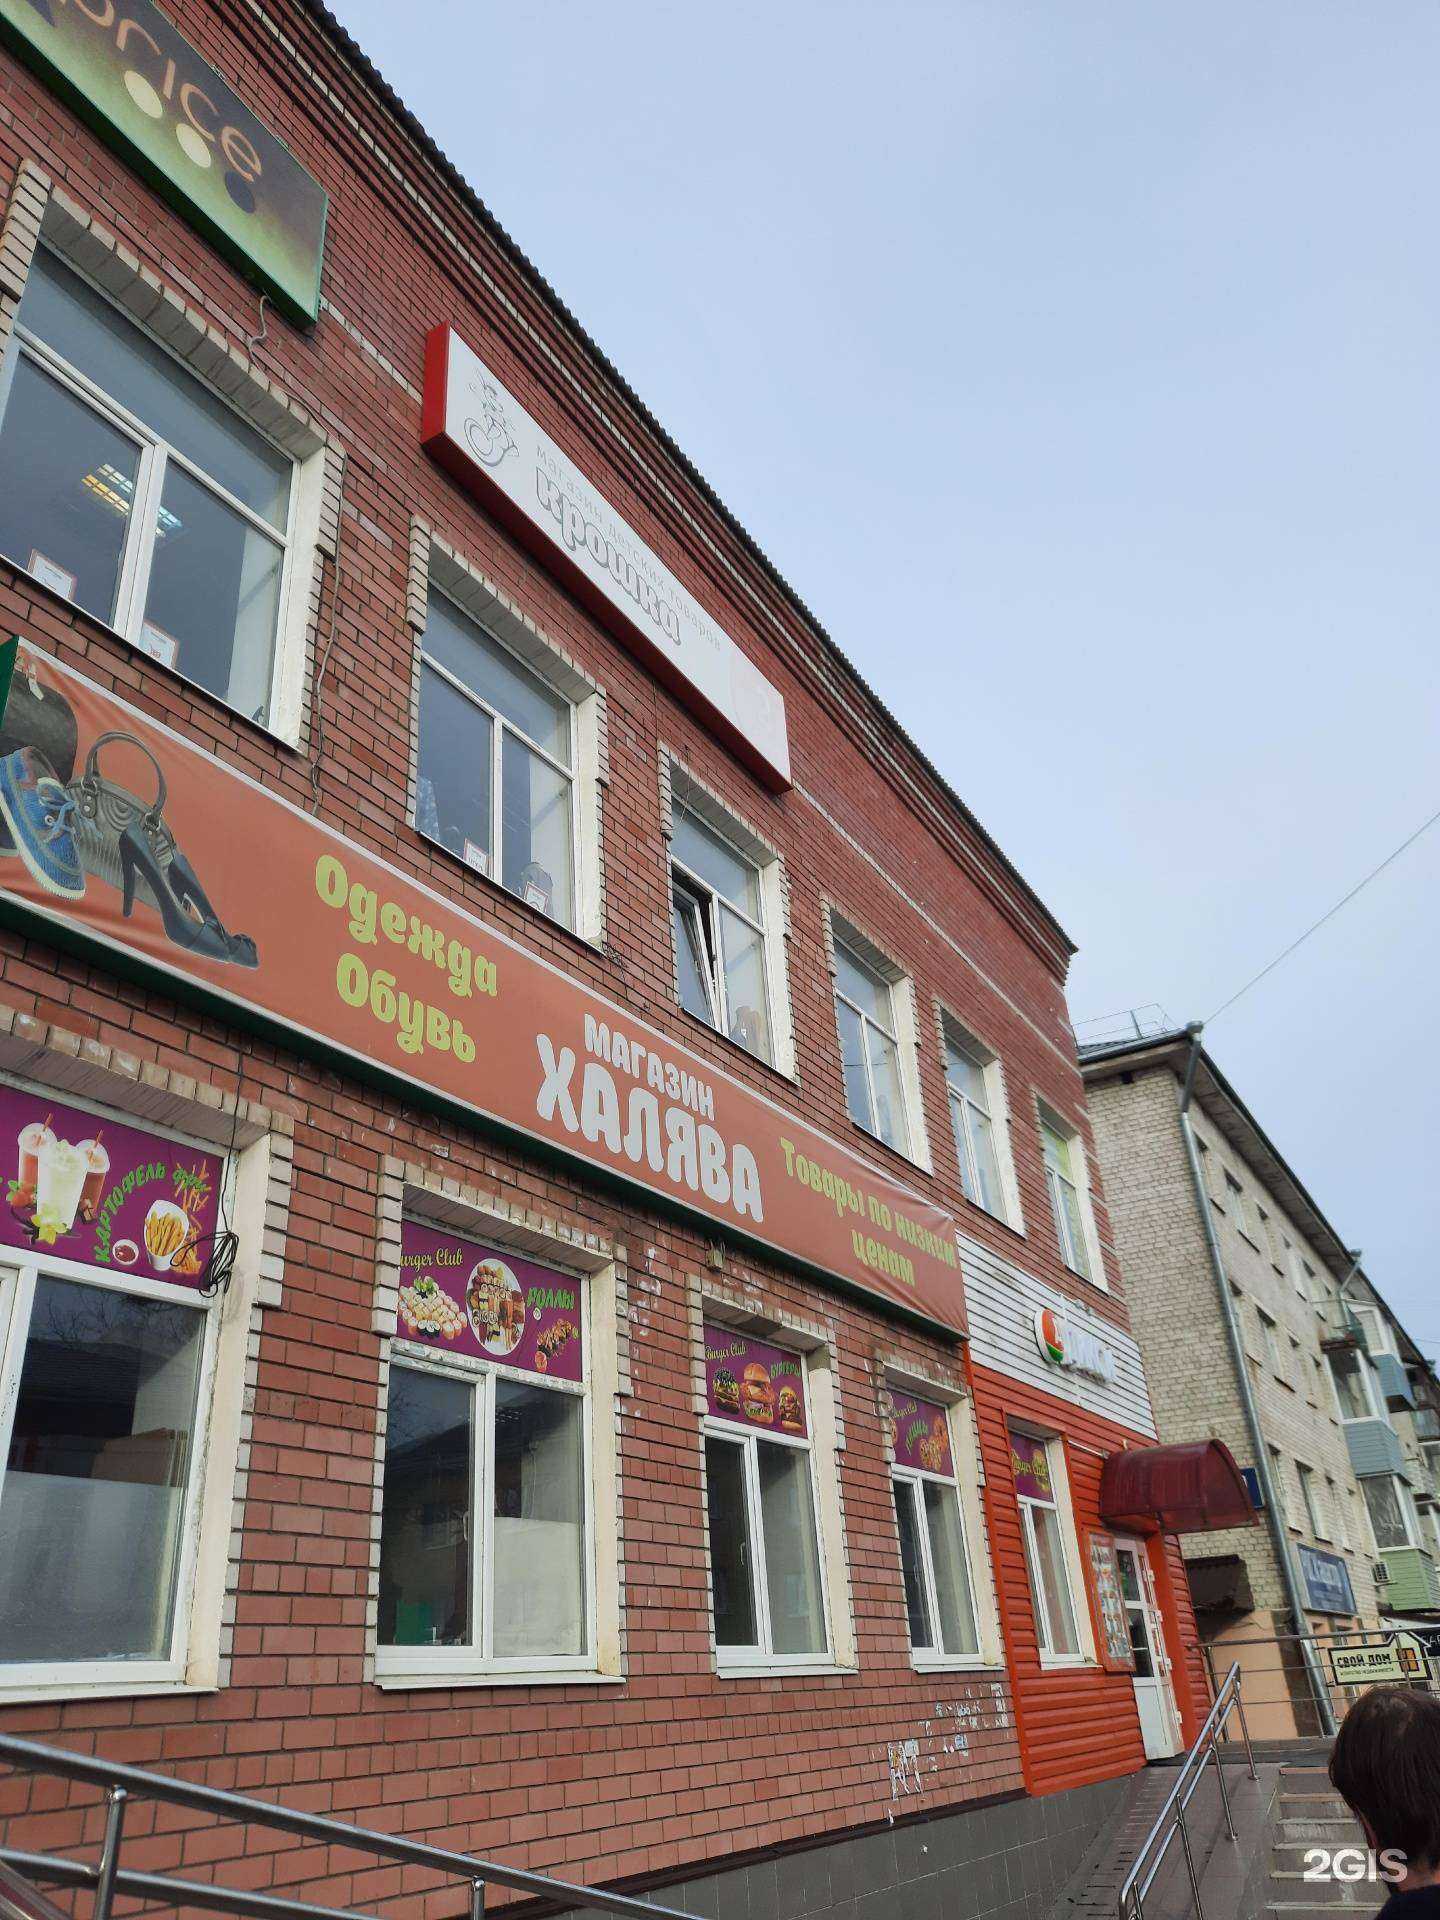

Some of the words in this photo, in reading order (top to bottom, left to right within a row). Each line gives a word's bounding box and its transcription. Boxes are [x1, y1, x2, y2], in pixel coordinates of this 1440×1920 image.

[316, 855, 497, 998] Одежда
[336, 953, 475, 1062] Обувь
[584, 1013, 715, 1121] МАГАЗИН
[536, 1033, 763, 1223] ХАЛЯВА
[779, 1137, 865, 1217] Товары
[868, 1195, 892, 1232] по
[895, 1212, 957, 1269] низким
[400, 1253, 433, 1272] urger
[435, 1248, 463, 1267] Club
[851, 1229, 915, 1288] ценам
[705, 1345, 729, 1364] Burger
[730, 1341, 747, 1357] Club
[1337, 1654, 1365, 1669] СВОЙ
[1368, 1653, 1392, 1667] ДОМ
